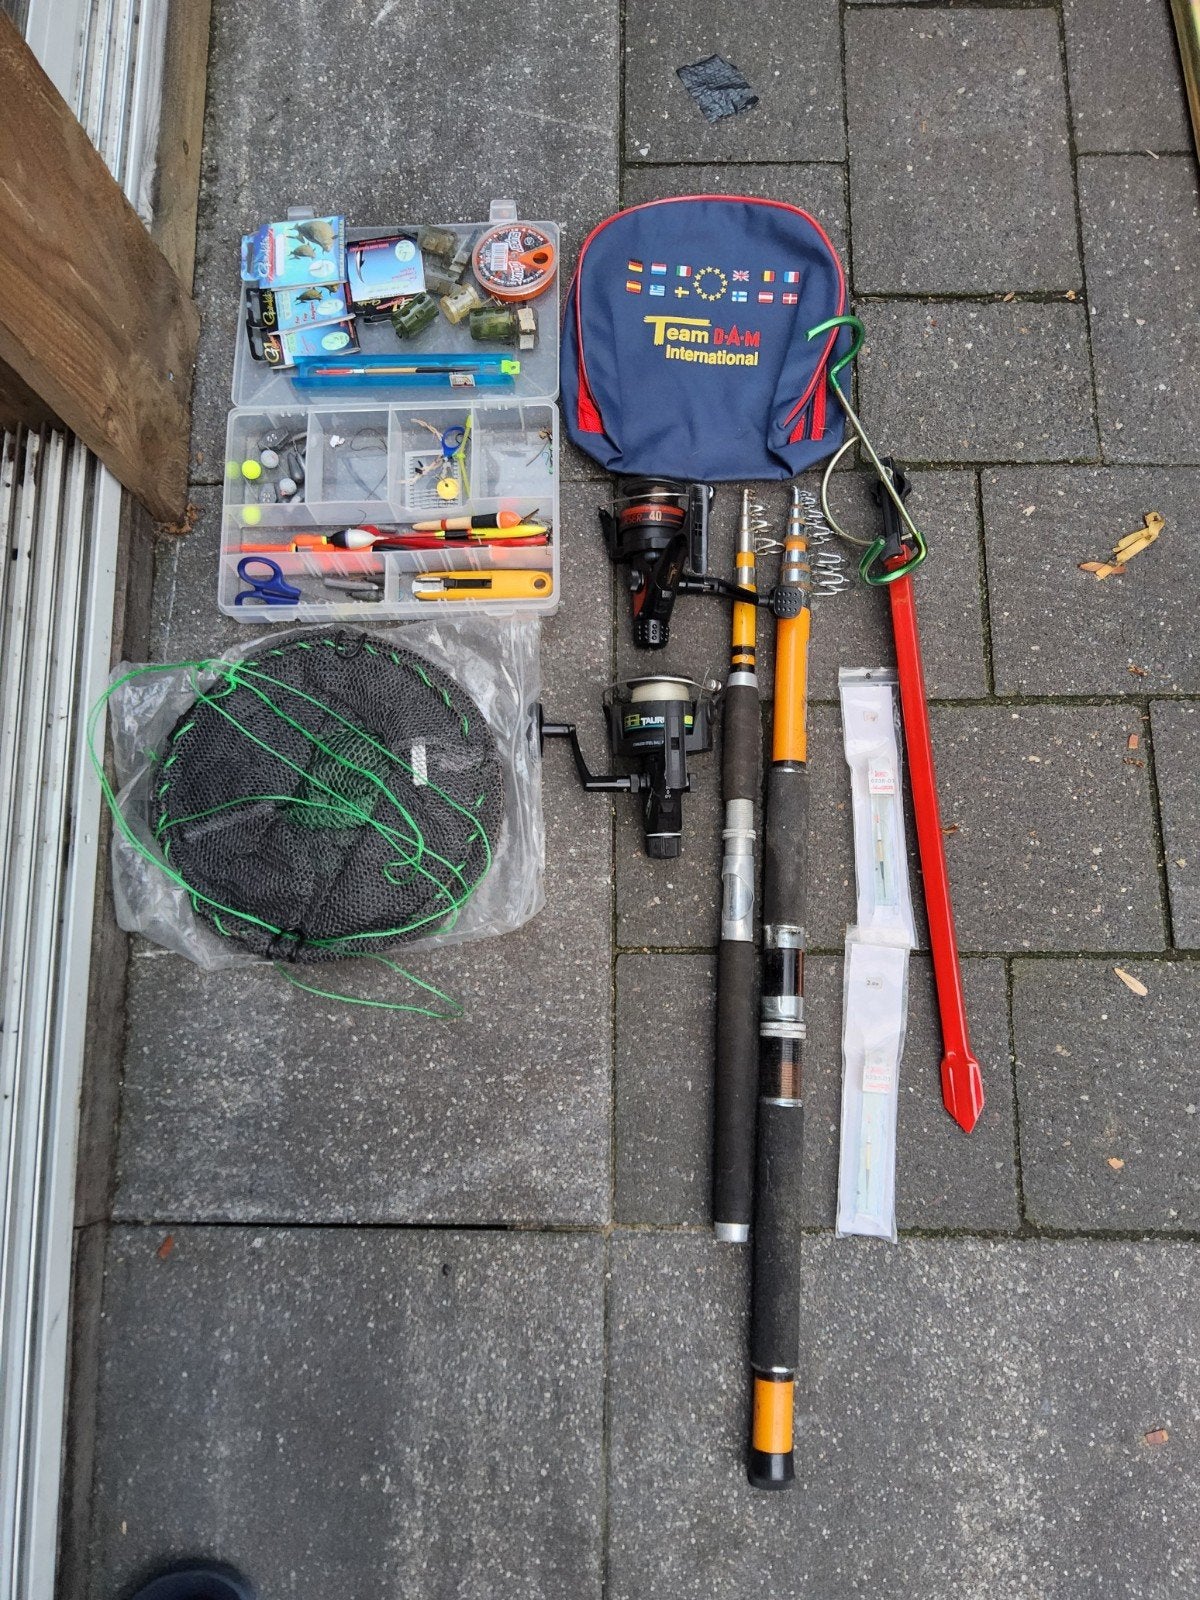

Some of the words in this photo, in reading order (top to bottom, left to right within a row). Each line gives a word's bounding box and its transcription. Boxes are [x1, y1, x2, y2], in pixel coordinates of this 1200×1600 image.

[643, 315, 712, 346] Team
[665, 344, 759, 366] International
[648, 510, 662, 522] 40
